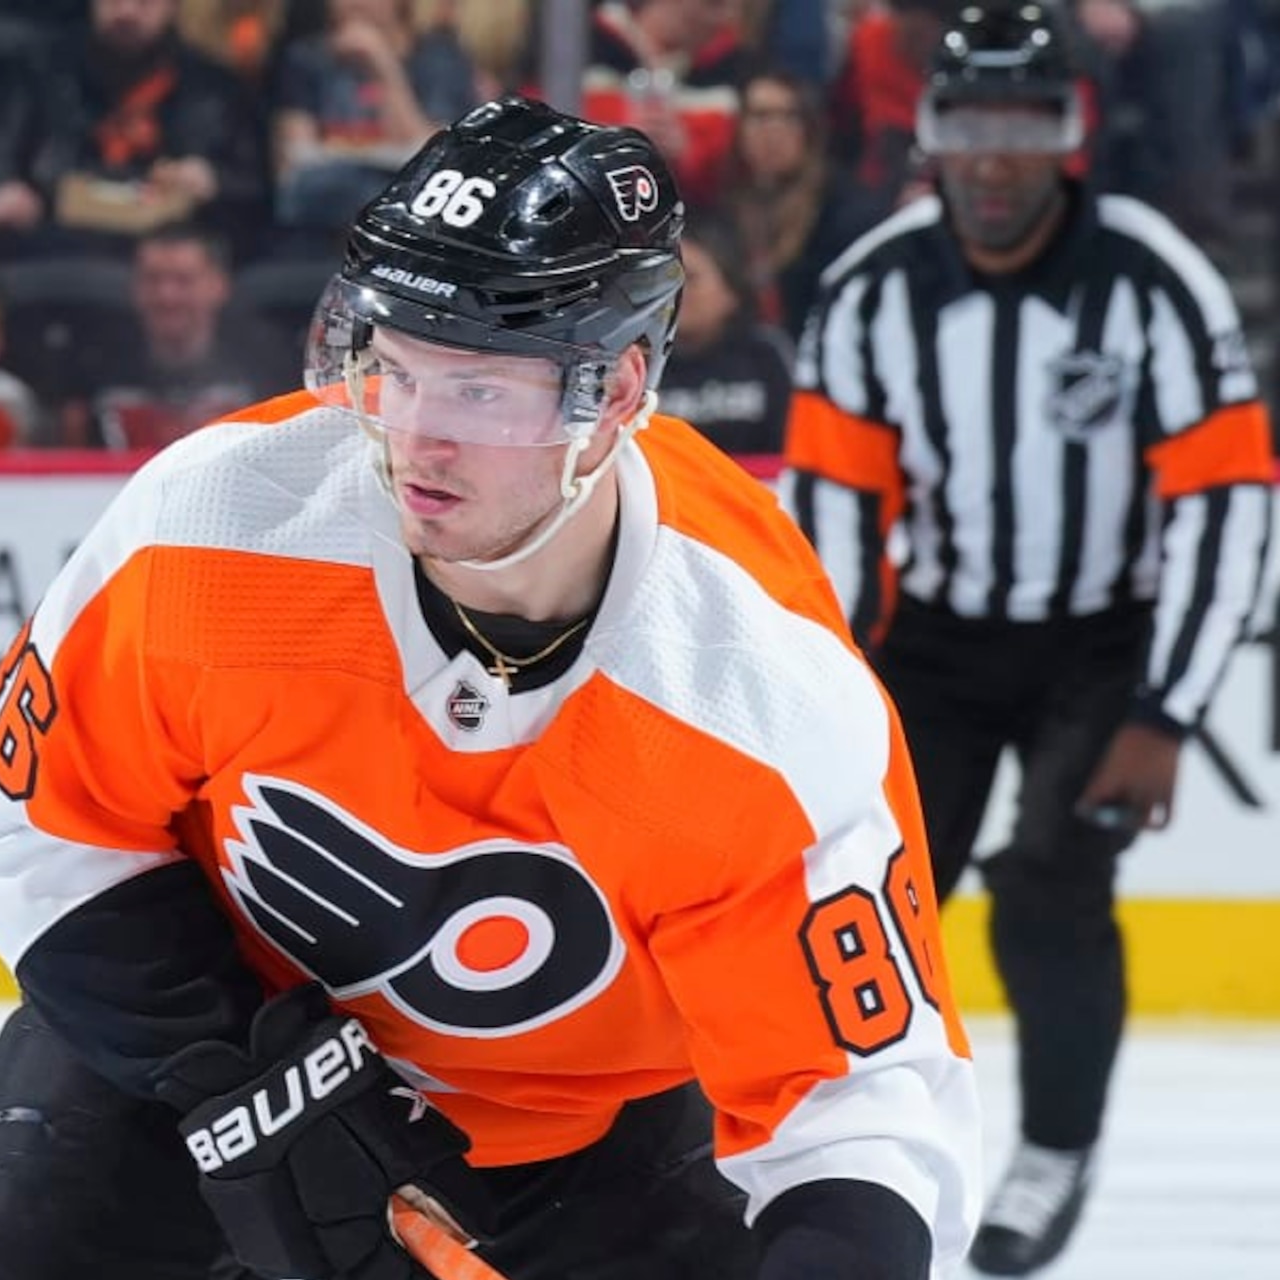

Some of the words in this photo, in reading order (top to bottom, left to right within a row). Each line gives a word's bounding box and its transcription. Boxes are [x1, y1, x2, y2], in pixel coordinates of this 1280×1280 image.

[411, 168, 497, 228] 86
[370, 264, 458, 298] BAUER
[186, 1018, 379, 1173] BAUER
